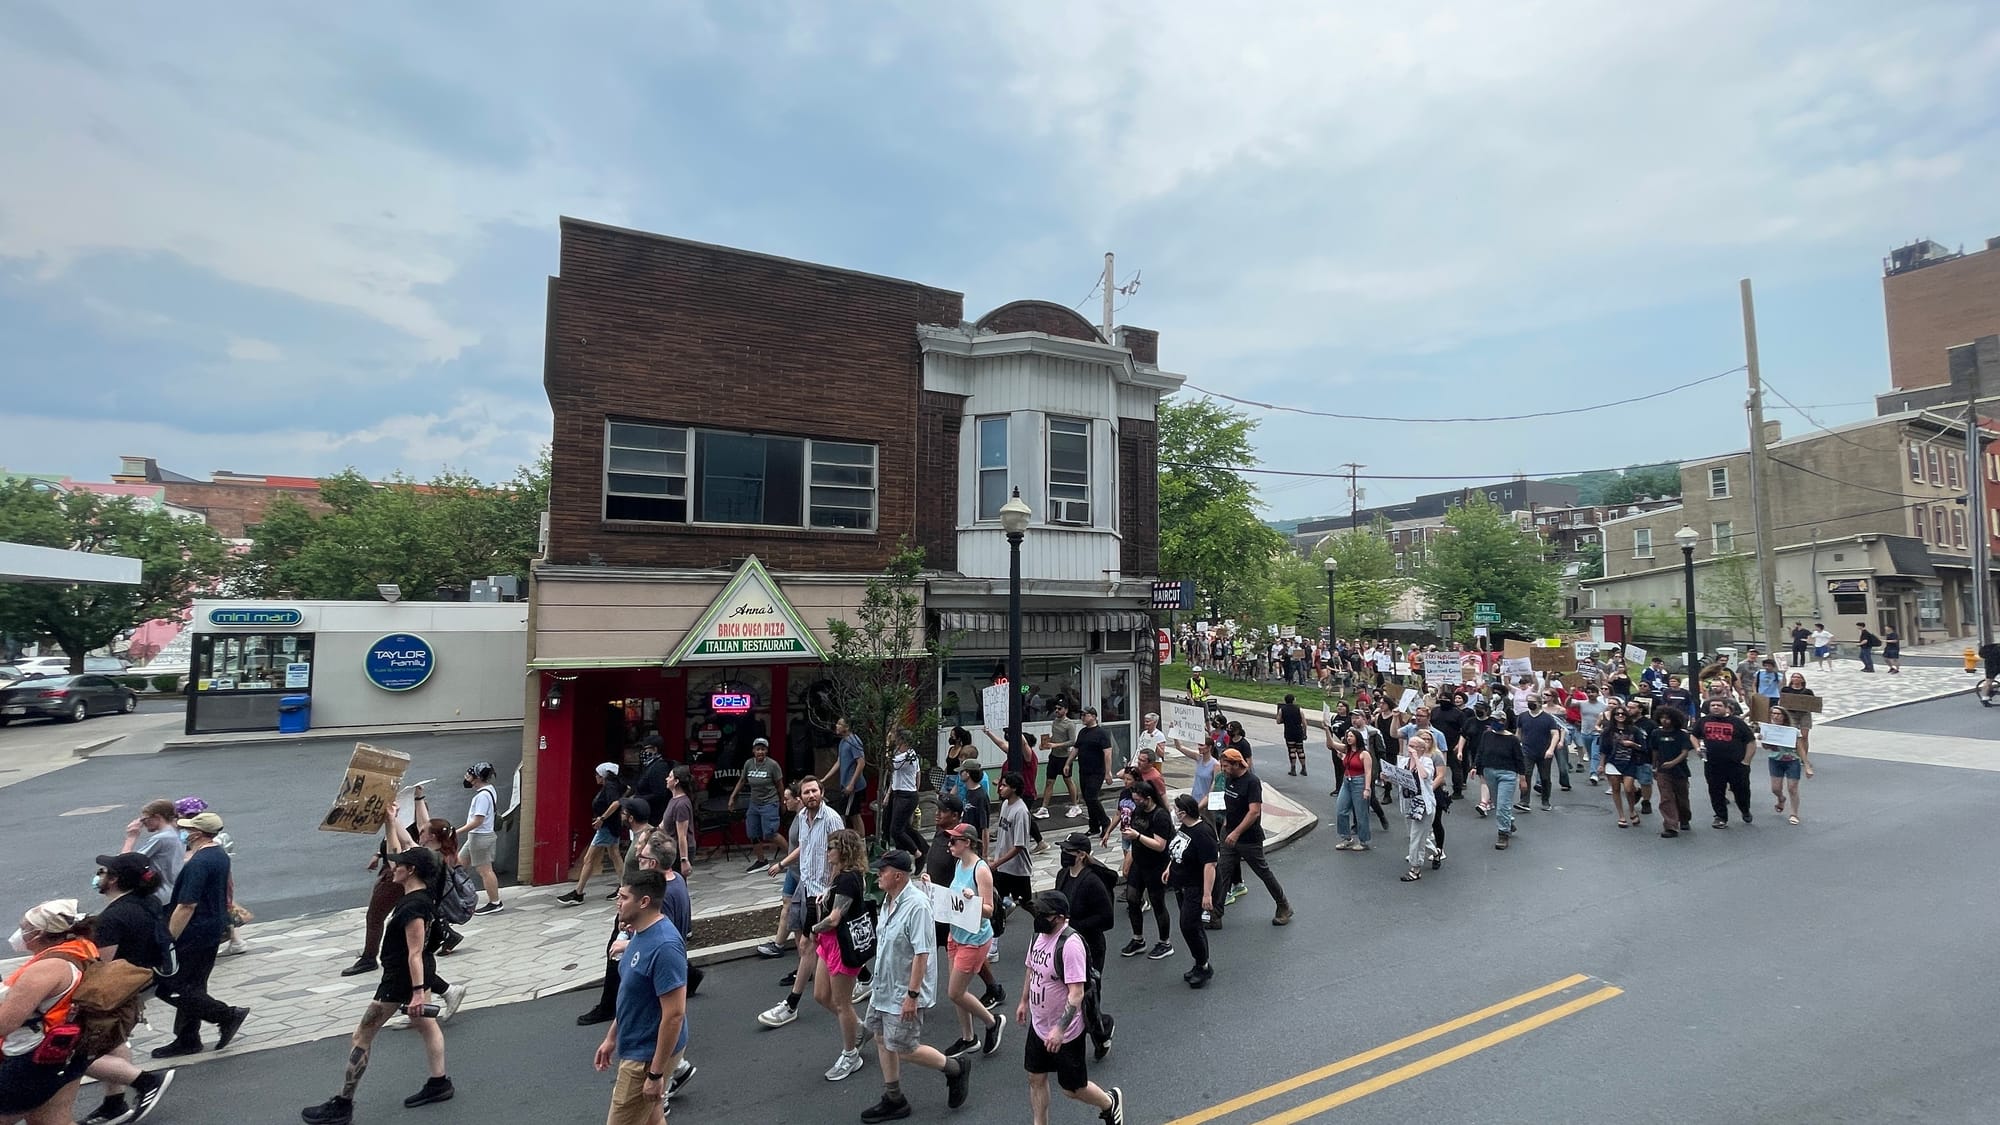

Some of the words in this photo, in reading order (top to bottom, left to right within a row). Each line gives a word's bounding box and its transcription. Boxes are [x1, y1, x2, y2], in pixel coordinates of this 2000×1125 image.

[1443, 488, 1513, 508] LEHGH
[1153, 589, 1180, 602] HAIRCUT
[217, 612, 250, 622] mini
[254, 612, 293, 622] mart
[729, 603, 774, 618] Anna's
[764, 622, 785, 636] PIZZA
[706, 640, 740, 653] ITALIAN
[743, 639, 795, 652] RESTAURANT
[374, 650, 426, 660] TAYLOR
[390, 659, 426, 667] Family
[714, 696, 749, 707] OPEN
